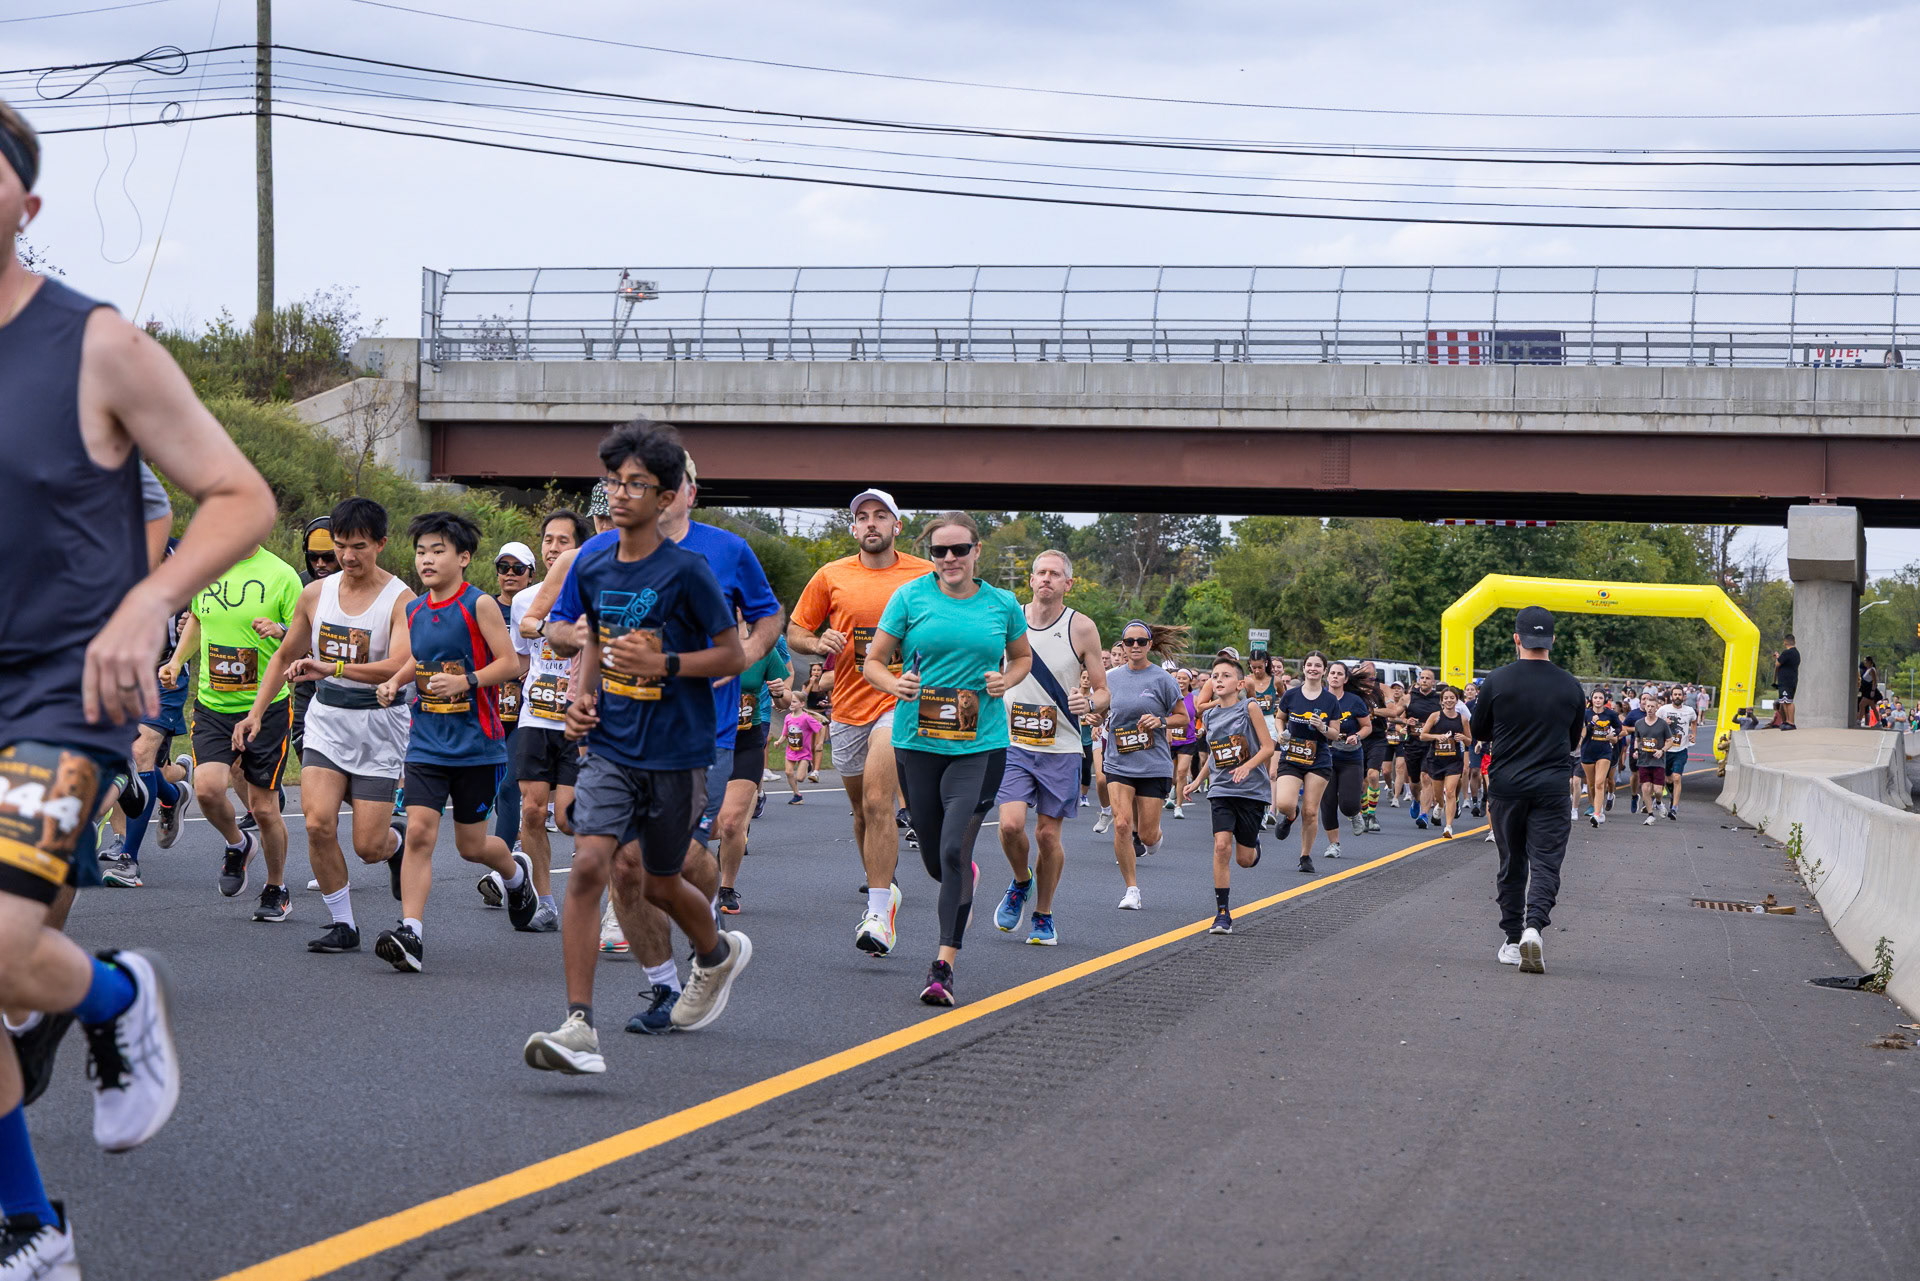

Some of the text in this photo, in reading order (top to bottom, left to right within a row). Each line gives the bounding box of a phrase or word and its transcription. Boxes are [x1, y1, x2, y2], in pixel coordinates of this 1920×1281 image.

[326, 640, 358, 659] 211
[215, 661, 246, 675] 40
[530, 687, 567, 704] 263
[738, 705, 753, 717] 2
[939, 704, 957, 720] 2
[1013, 715, 1053, 730] 229
[1120, 732, 1149, 746] 128
[1215, 745, 1242, 760] 127
[1291, 745, 1313, 756] 193
